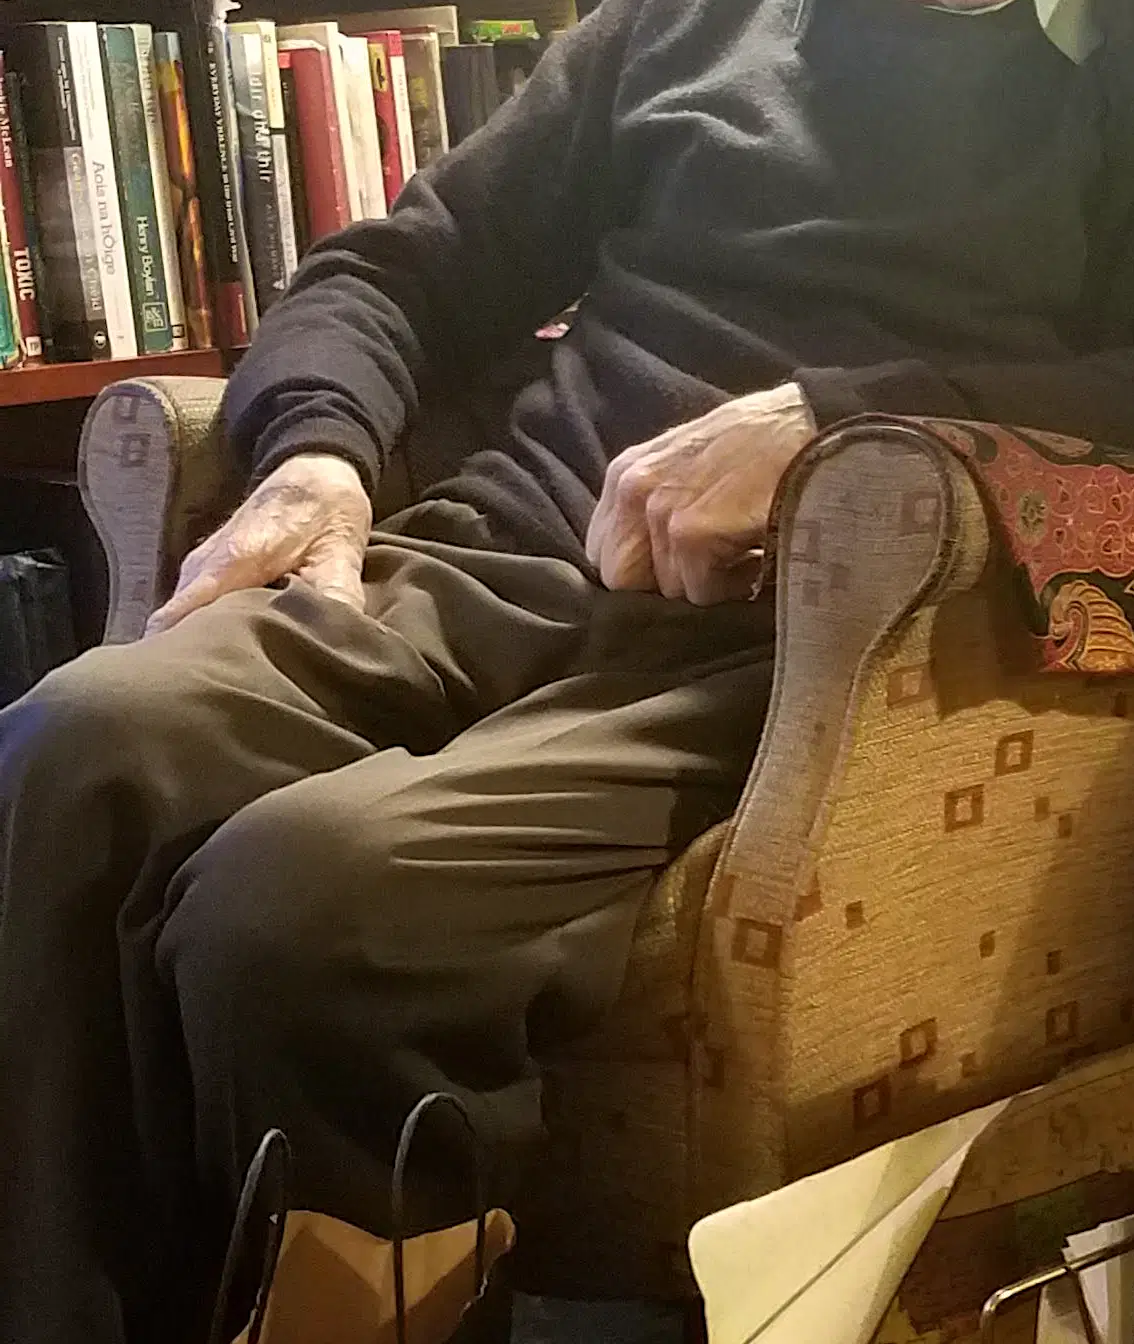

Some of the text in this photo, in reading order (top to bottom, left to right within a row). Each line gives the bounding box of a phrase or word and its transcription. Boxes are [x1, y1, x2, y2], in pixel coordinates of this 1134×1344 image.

[208, 62, 223, 117] EVERYDAY
[13, 246, 36, 302] TOXIC
[135, 215, 156, 297] Henry Boylan
